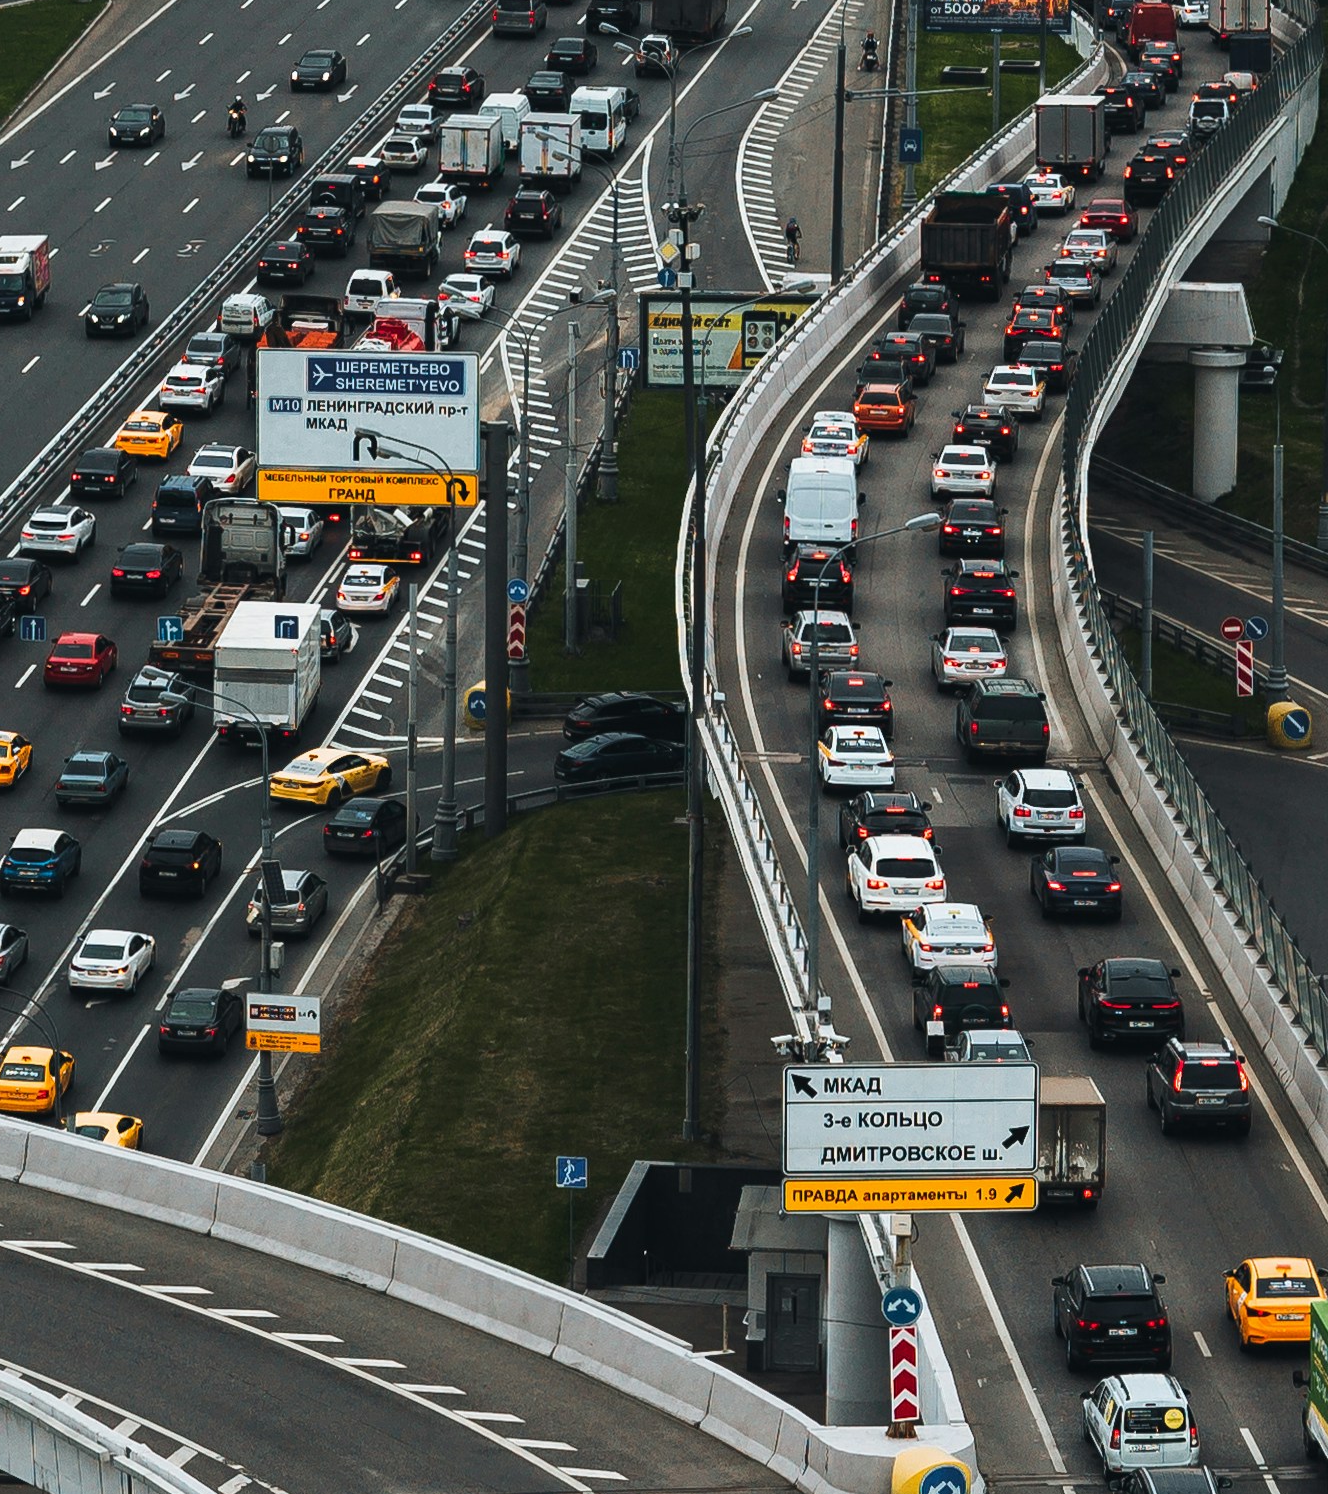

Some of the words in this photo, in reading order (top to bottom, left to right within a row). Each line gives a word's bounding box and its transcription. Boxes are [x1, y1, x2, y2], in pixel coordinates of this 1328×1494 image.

[336, 362, 450, 376] ШЕРЕМЕТЬЕВО
[307, 400, 434, 415] ЛЕНИНГРАДСКИЙ
[439, 407, 468, 417] пр-т
[306, 418, 348, 431] МКАД
[265, 473, 326, 482] МЕБЕЛЬНЫЙ
[330, 475, 383, 484] ТОРГОВЫЙ
[386, 477, 438, 486] КОМПЛЕКС
[328, 488, 375, 502] ГРАНД
[823, 1077, 882, 1096] МКАД
[823, 1113, 852, 1128] 3-е
[858, 1111, 943, 1130] КОЛЬЦО
[821, 1145, 976, 1165] ДМИТРОВСКОЕ
[982, 1148, 1003, 1162] ш.
[792, 1190, 857, 1203] ПРАВДА
[862, 1189, 968, 1204] апартаменты
[976, 1189, 997, 1201] 1.9
